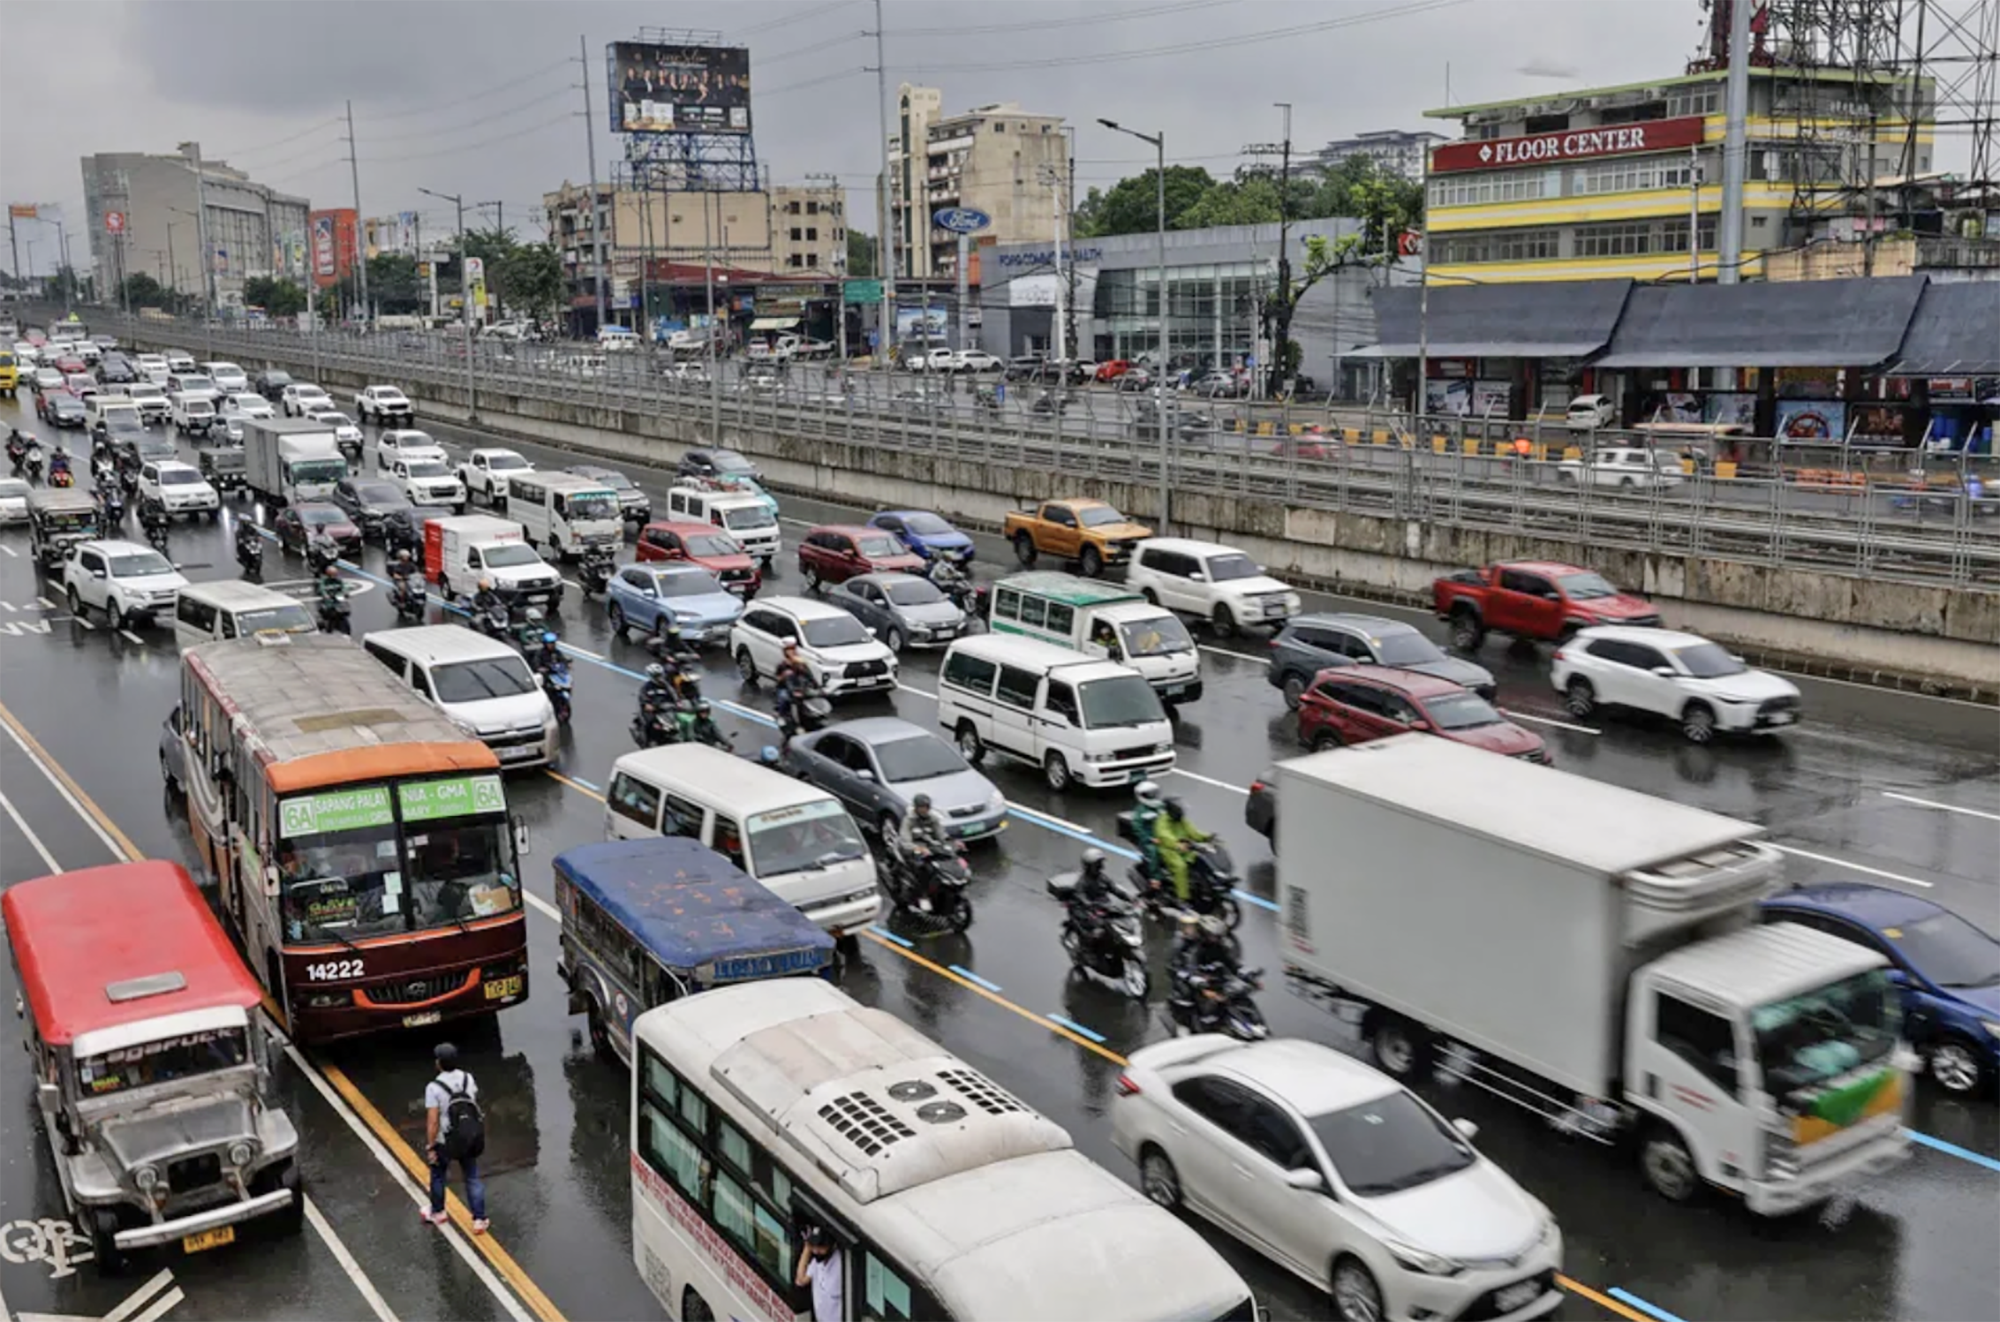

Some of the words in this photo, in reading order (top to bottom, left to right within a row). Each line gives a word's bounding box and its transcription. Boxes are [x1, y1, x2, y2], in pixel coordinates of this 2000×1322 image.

[1495, 137, 1559, 162] FLOOR
[1564, 127, 1645, 155] CENTER
[949, 212, 979, 227] Ford
[286, 806, 313, 830] 6A
[437, 784, 468, 800] GMA
[477, 783, 502, 807] 6A
[306, 959, 365, 981] 14222
